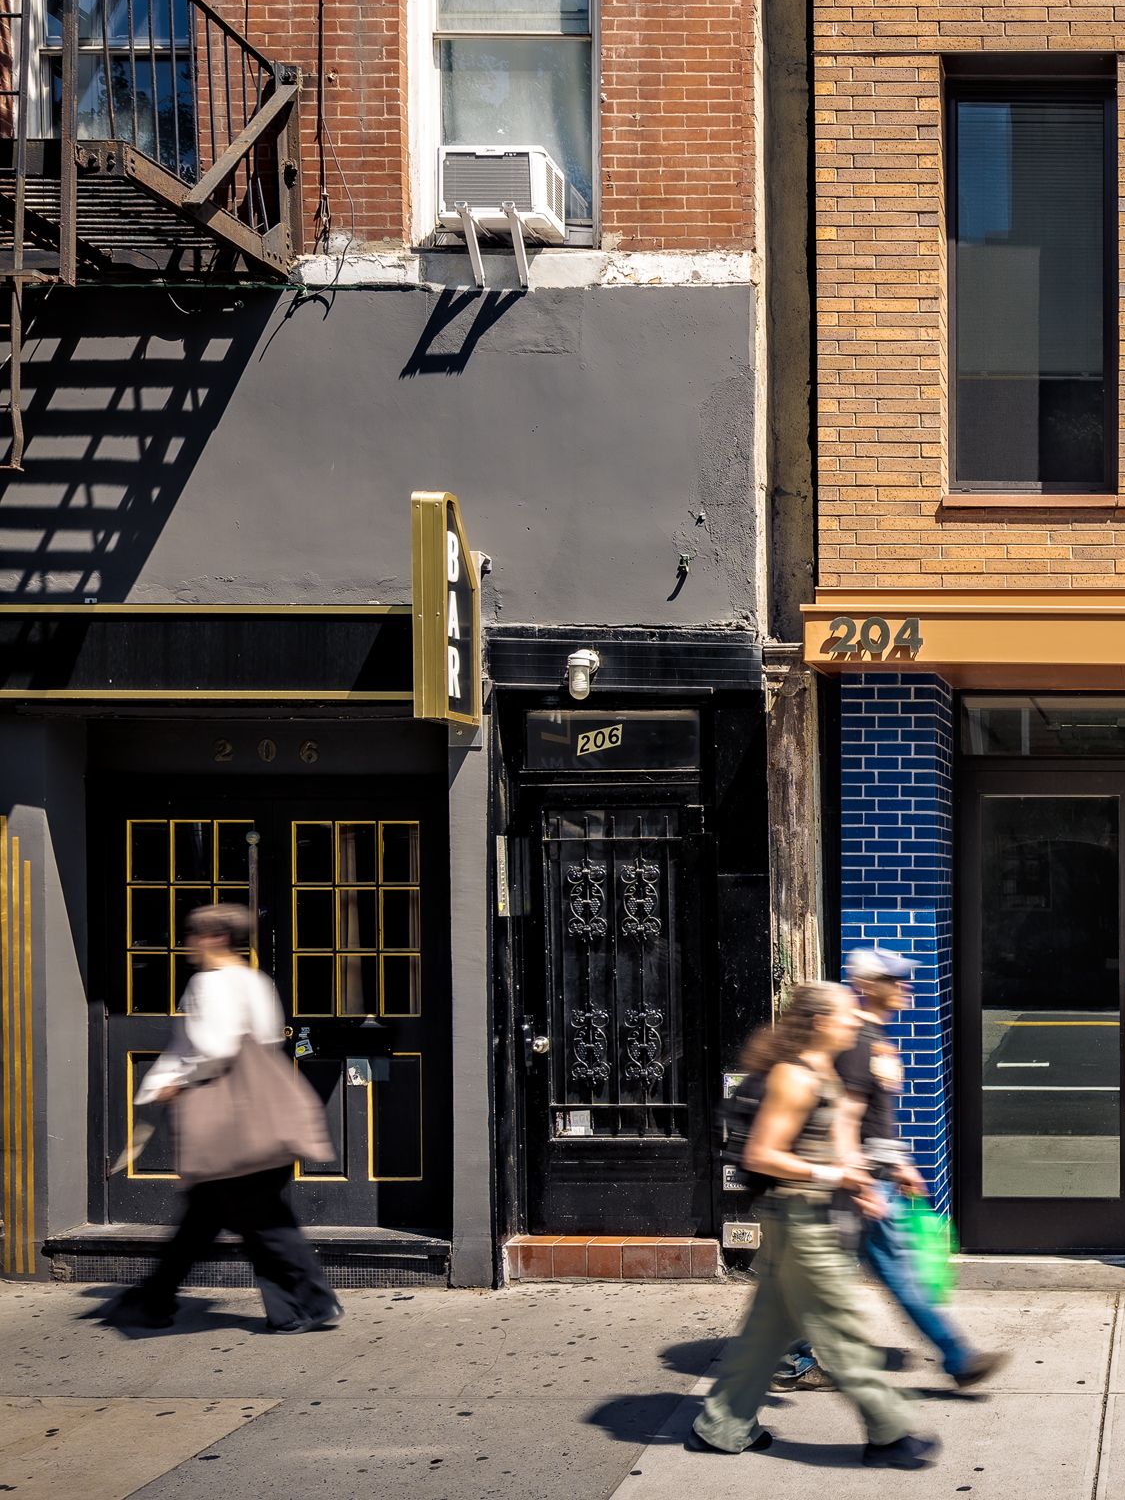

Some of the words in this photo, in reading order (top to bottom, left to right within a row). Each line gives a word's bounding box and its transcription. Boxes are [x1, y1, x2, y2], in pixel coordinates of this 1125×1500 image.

[447, 530, 461, 699] BAR
[829, 616, 923, 653] 204
[214, 739, 319, 763] 206
[580, 727, 620, 753] 206
